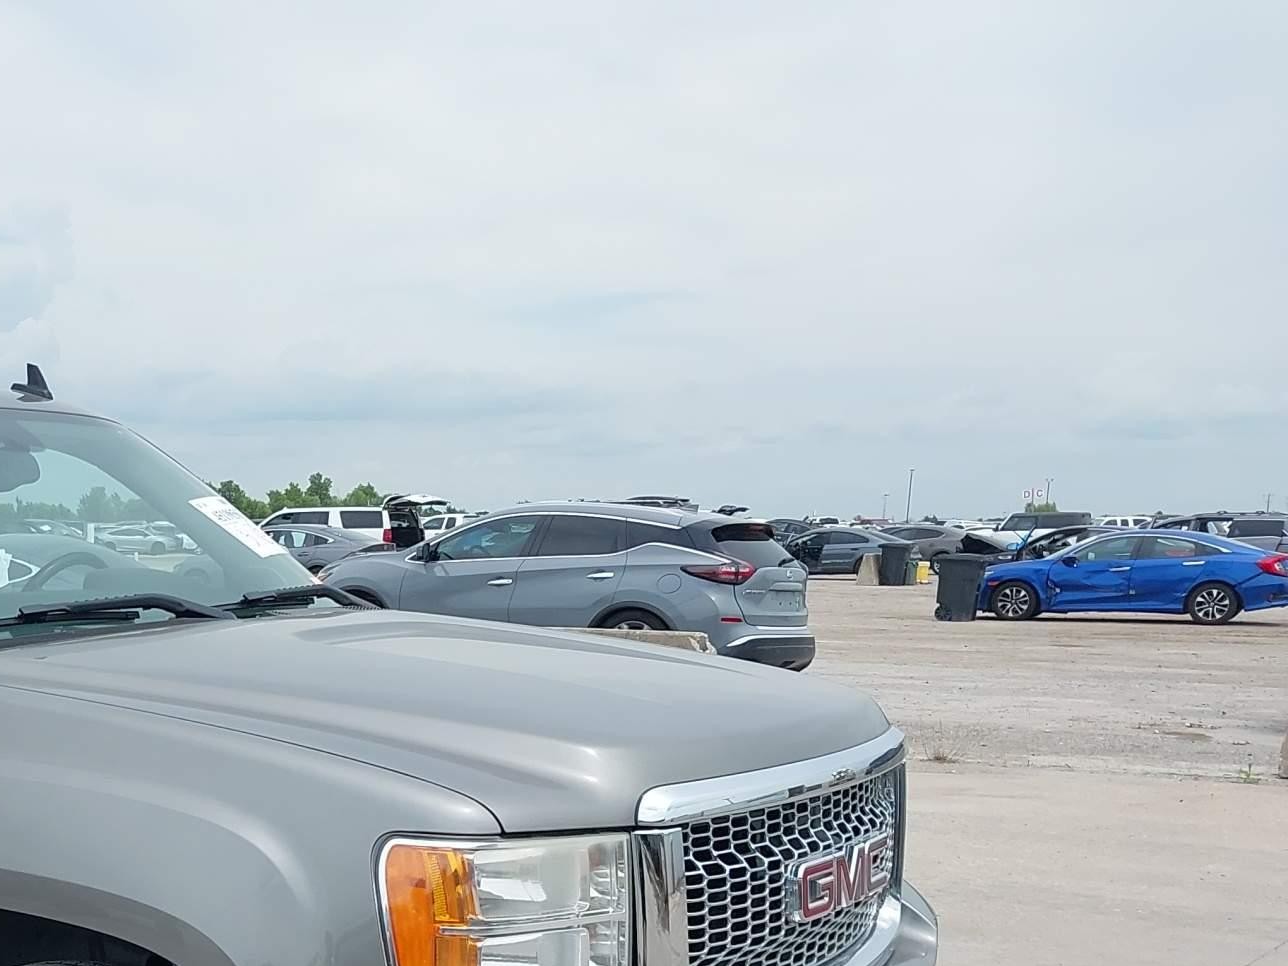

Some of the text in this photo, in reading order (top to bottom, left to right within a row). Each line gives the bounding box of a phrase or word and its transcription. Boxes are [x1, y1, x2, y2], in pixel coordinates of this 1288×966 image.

[1023, 490, 1031, 499] D
[1036, 489, 1044, 498] C
[797, 834, 889, 920] GMC
